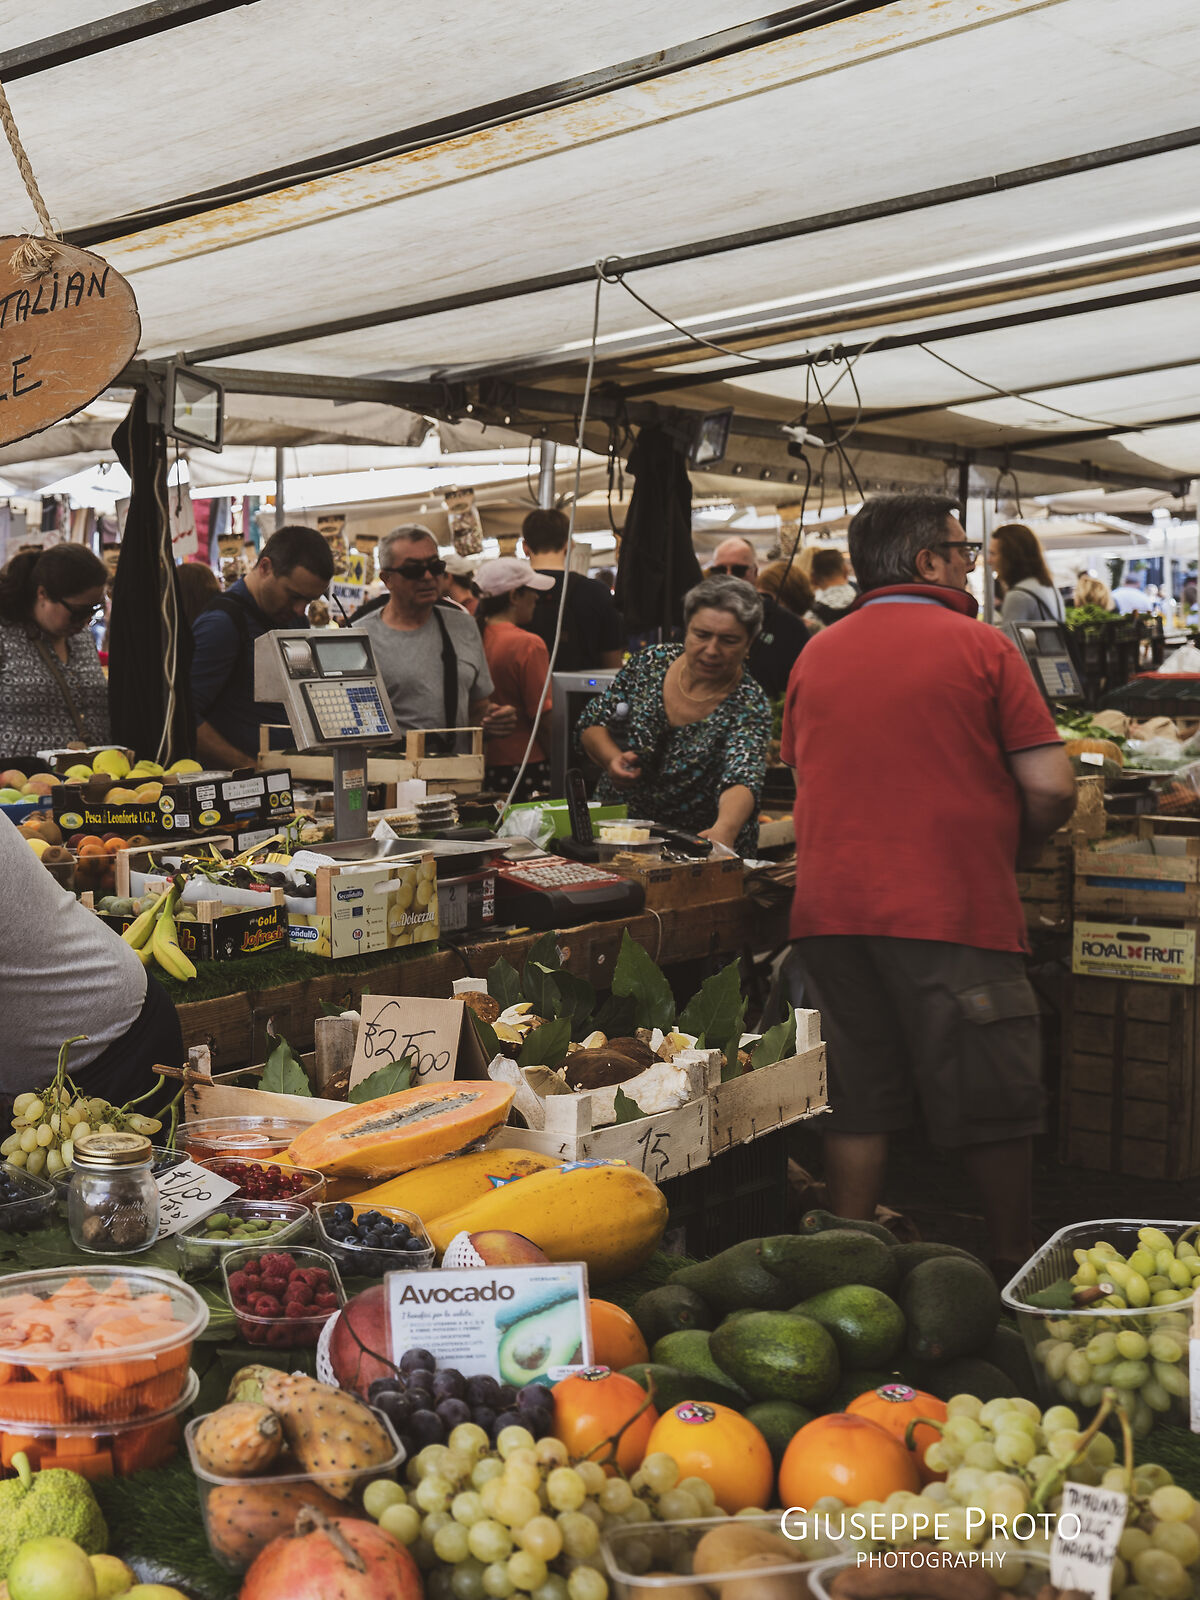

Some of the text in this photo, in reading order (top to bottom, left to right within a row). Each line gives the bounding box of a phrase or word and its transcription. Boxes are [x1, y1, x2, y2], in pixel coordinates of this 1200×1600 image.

[85, 811, 102, 824] Pesca
[107, 810, 138, 824] Leonforte
[139, 811, 158, 824] I.G.P.
[257, 909, 277, 927] Gold
[401, 912, 435, 926] Dolcezza
[241, 925, 284, 951] Jofresh
[288, 930, 317, 939] condulfo
[1081, 941, 1127, 959] ROYAL
[1143, 946, 1185, 965] FRUIT
[637, 1127, 671, 1174] 15
[398, 1280, 515, 1305] Avocado
